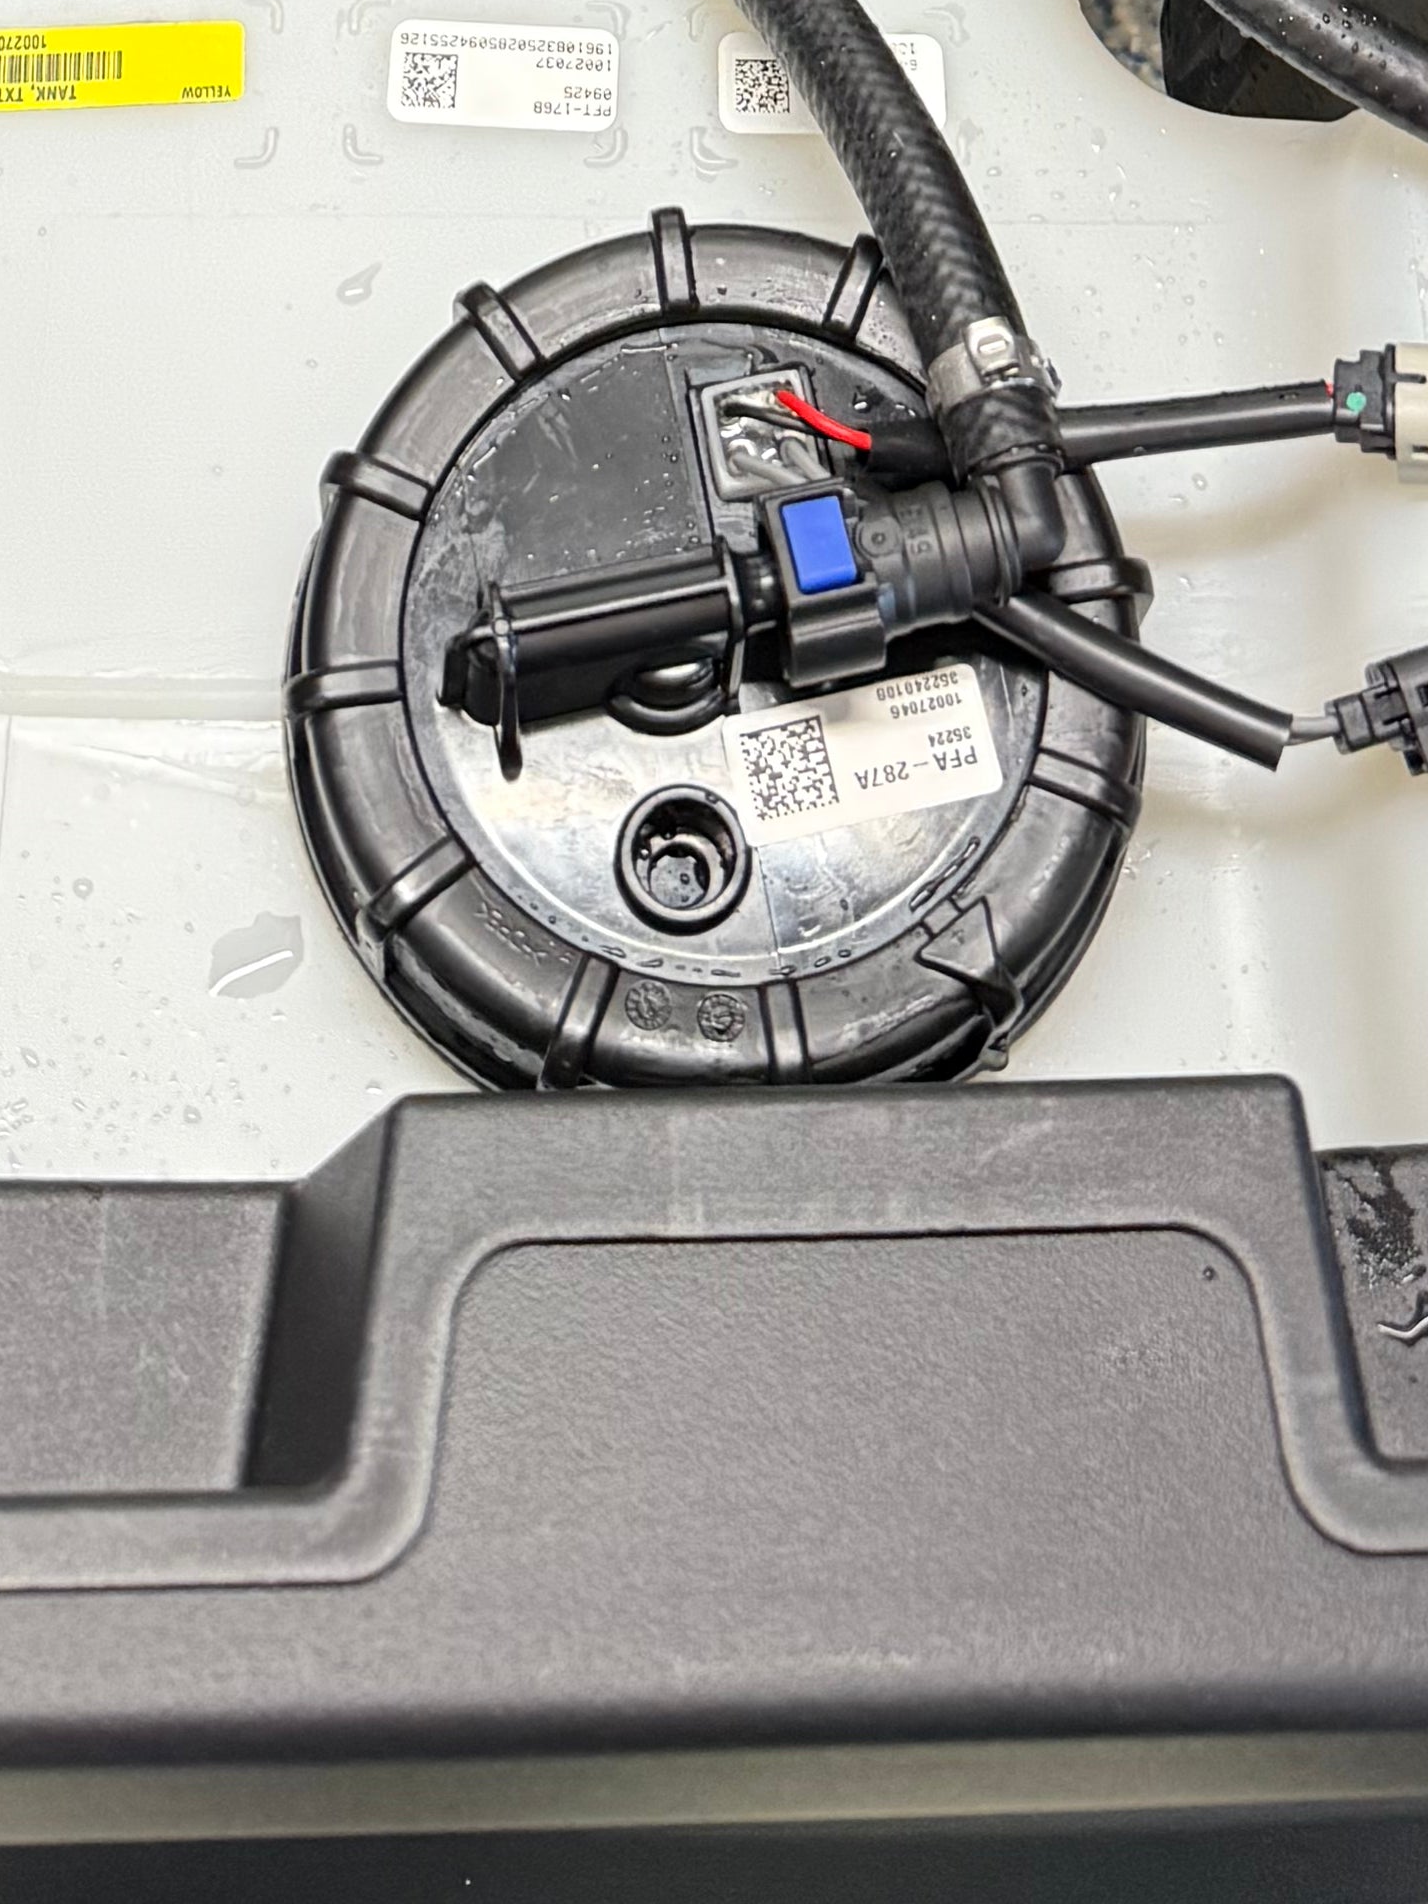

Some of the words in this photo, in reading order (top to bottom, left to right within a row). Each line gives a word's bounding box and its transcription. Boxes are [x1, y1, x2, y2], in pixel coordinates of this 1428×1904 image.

[535, 56, 612, 72] 10027037
[31, 83, 77, 101] TANK,
[181, 84, 232, 99] YELLOW
[563, 86, 612, 101] 09425
[890, 692, 963, 719] 10027046
[927, 725, 972, 748] 35224
